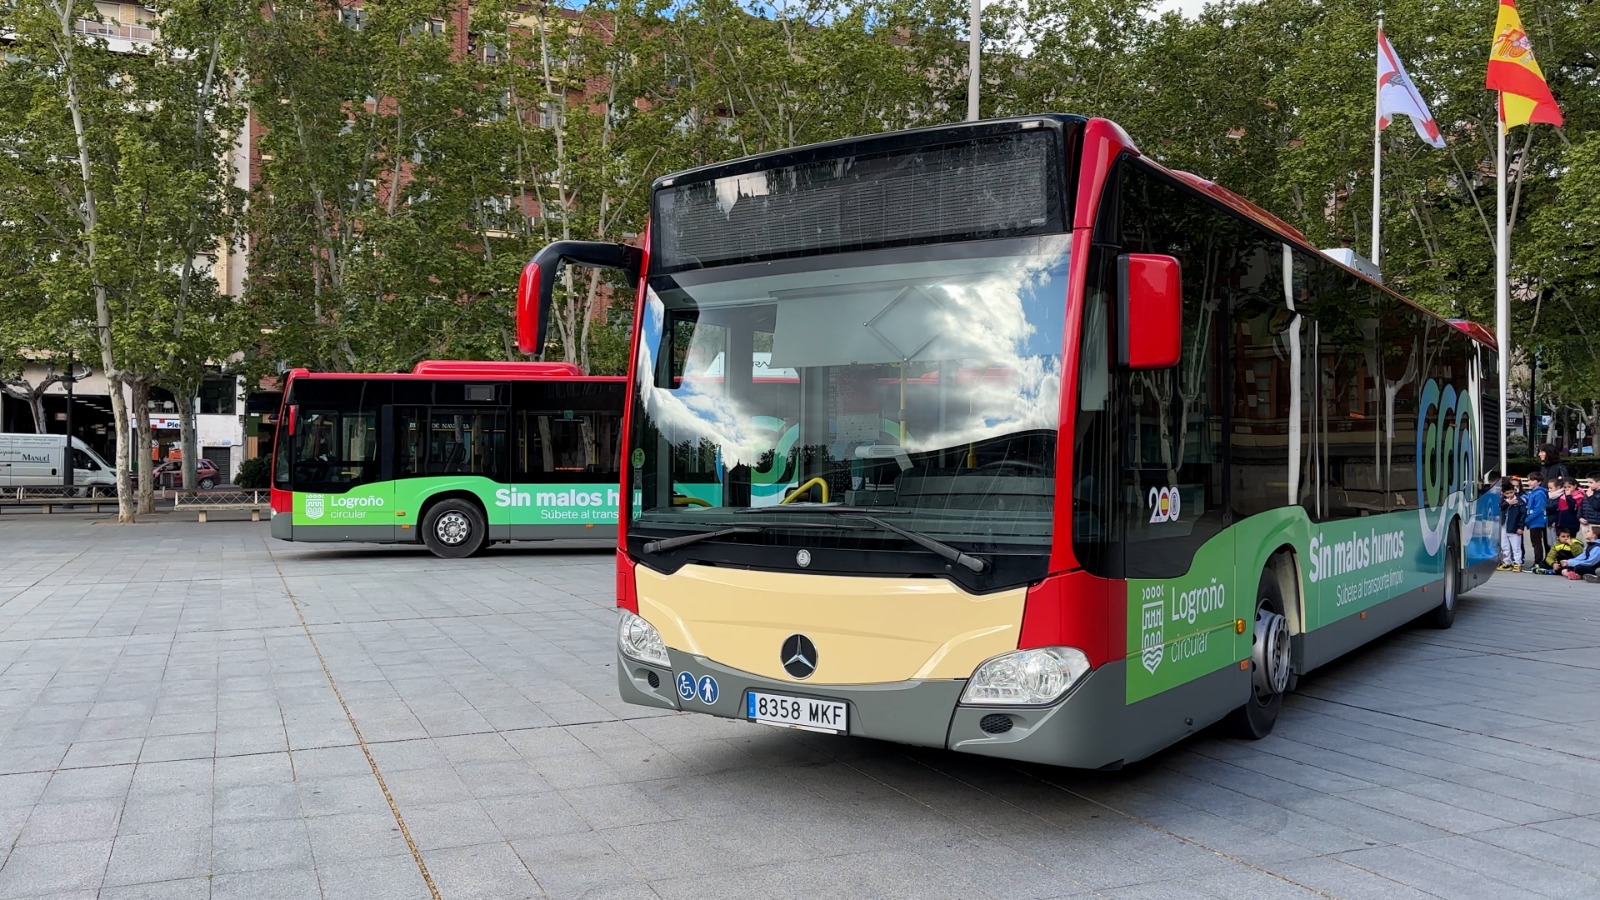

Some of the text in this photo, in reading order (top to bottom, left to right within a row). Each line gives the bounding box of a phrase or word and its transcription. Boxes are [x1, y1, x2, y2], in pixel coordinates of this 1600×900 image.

[331, 495, 384, 509] Logroño
[495, 487, 531, 507] Sin
[536, 488, 603, 507] malos
[1148, 486, 1181, 524] 200
[330, 509, 367, 519] circular
[540, 509, 578, 519] Súbete
[581, 509, 590, 519] al
[1308, 528, 1404, 583] Sin malos humos
[1171, 577, 1225, 625] Logroño
[1336, 565, 1404, 607] Súbete al transporte limpio
[1170, 629, 1210, 663] circular
[759, 697, 843, 725] 8358 MKF
